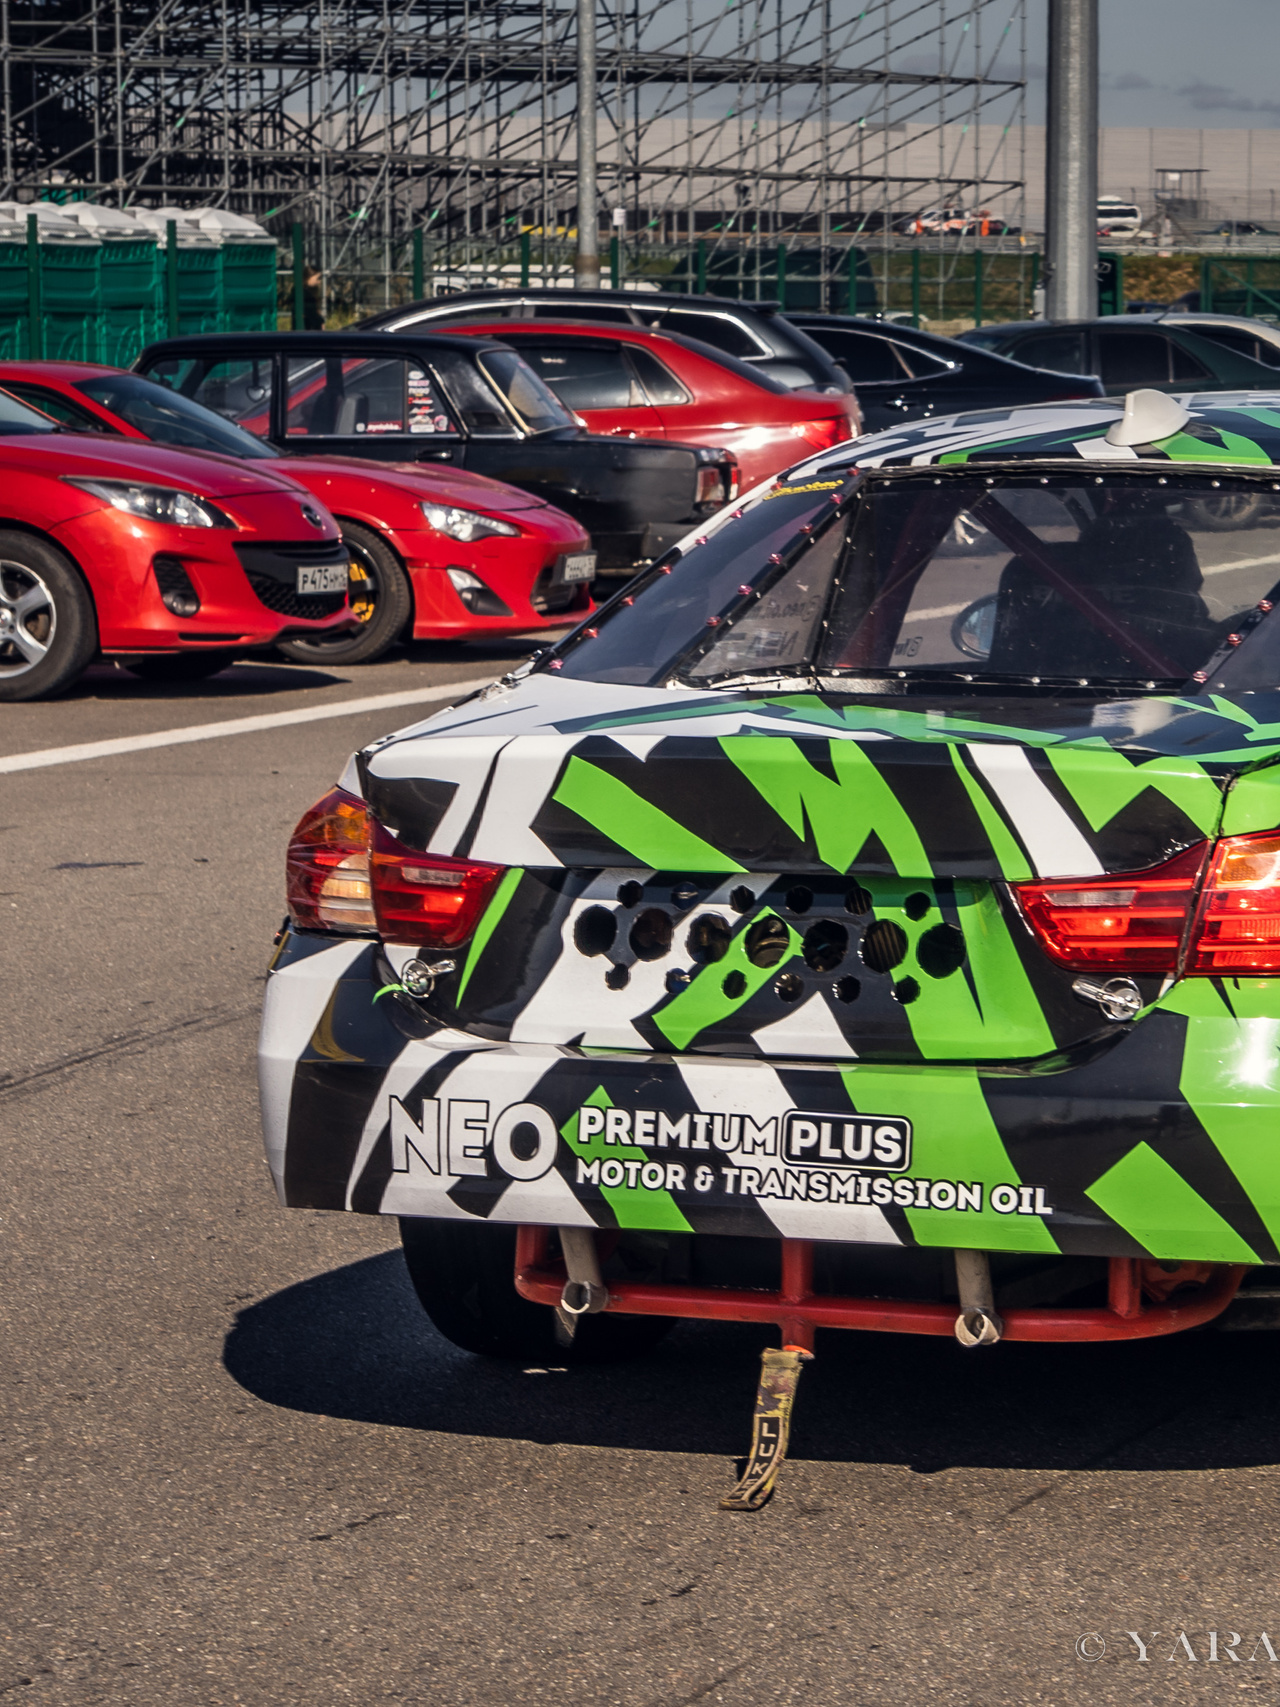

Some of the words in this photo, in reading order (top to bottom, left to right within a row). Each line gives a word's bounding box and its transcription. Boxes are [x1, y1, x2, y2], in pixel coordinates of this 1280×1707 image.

[389, 1096, 559, 1182] NEO
[577, 1105, 777, 1158] PREMIUM
[787, 1117, 904, 1164] PLUS
[575, 1157, 688, 1193] MOTOR
[693, 1165, 716, 1192] &
[721, 1166, 983, 1211] TRANSMISSION
[989, 1183, 1053, 1216] OIL
